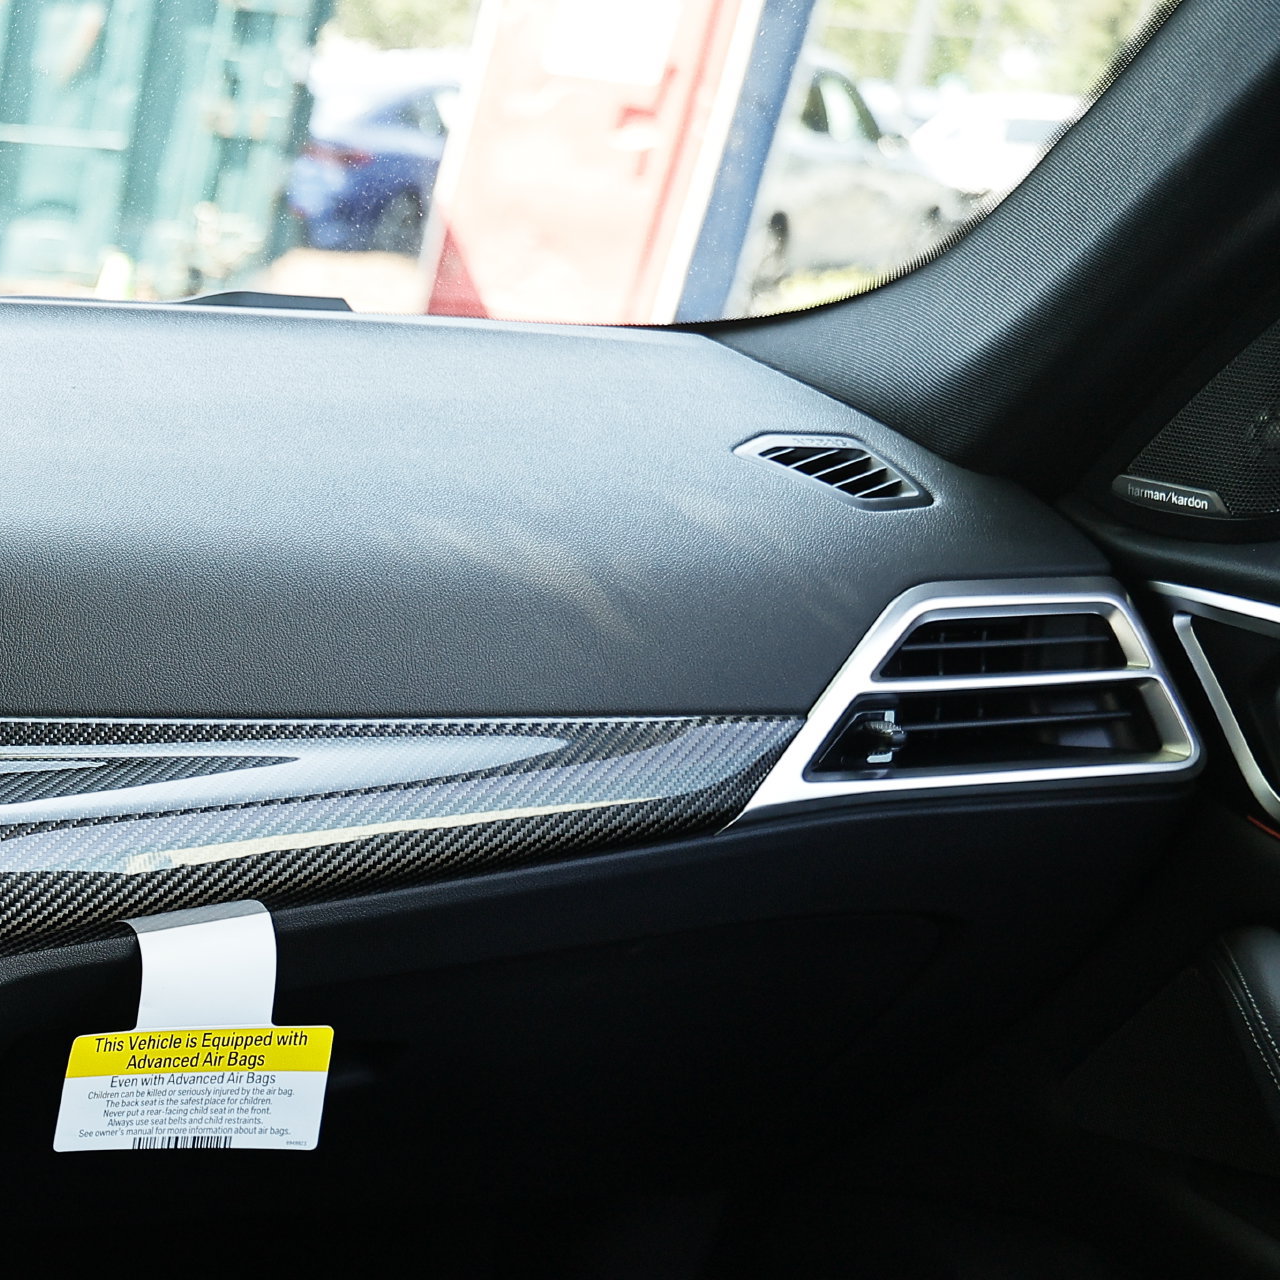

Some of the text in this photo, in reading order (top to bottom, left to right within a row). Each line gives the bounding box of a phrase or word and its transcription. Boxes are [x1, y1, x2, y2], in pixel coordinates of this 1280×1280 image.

[95, 1030, 308, 1053] This Vehicle is Equipped with
[126, 1051, 266, 1070] Advanced Air Bags
[110, 1071, 276, 1088] Even with Advanced Air Bags
[88, 1090, 120, 1100] Children
[120, 1091, 135, 1099] can
[136, 1090, 145, 1098] be
[146, 1088, 167, 1098] killed
[177, 1088, 211, 1099] seriously
[213, 1087, 240, 1098] injured
[241, 1087, 251, 1097] by
[252, 1087, 265, 1096] the
[266, 1087, 277, 1096] air
[278, 1087, 295, 1098] bag.
[106, 1097, 273, 1108] The back seat is the safest place for children.
[103, 1109, 125, 1118] Never
[126, 1109, 139, 1118] put
[146, 1107, 188, 1118] rear-facing
[189, 1106, 208, 1115] child
[210, 1107, 226, 1115] seat
[228, 1107, 235, 1115] in
[236, 1106, 249, 1115] the
[250, 1106, 272, 1115] front.
[107, 1116, 263, 1128] Always use seat belts and child restraints.
[79, 1129, 93, 1138] See
[126, 1127, 154, 1136] manual
[155, 1126, 166, 1135] for
[167, 1127, 187, 1135] more
[188, 1126, 232, 1135] information
[234, 1126, 256, 1135] about
[258, 1126, 268, 1135] air
[269, 1126, 291, 1137] bags.
